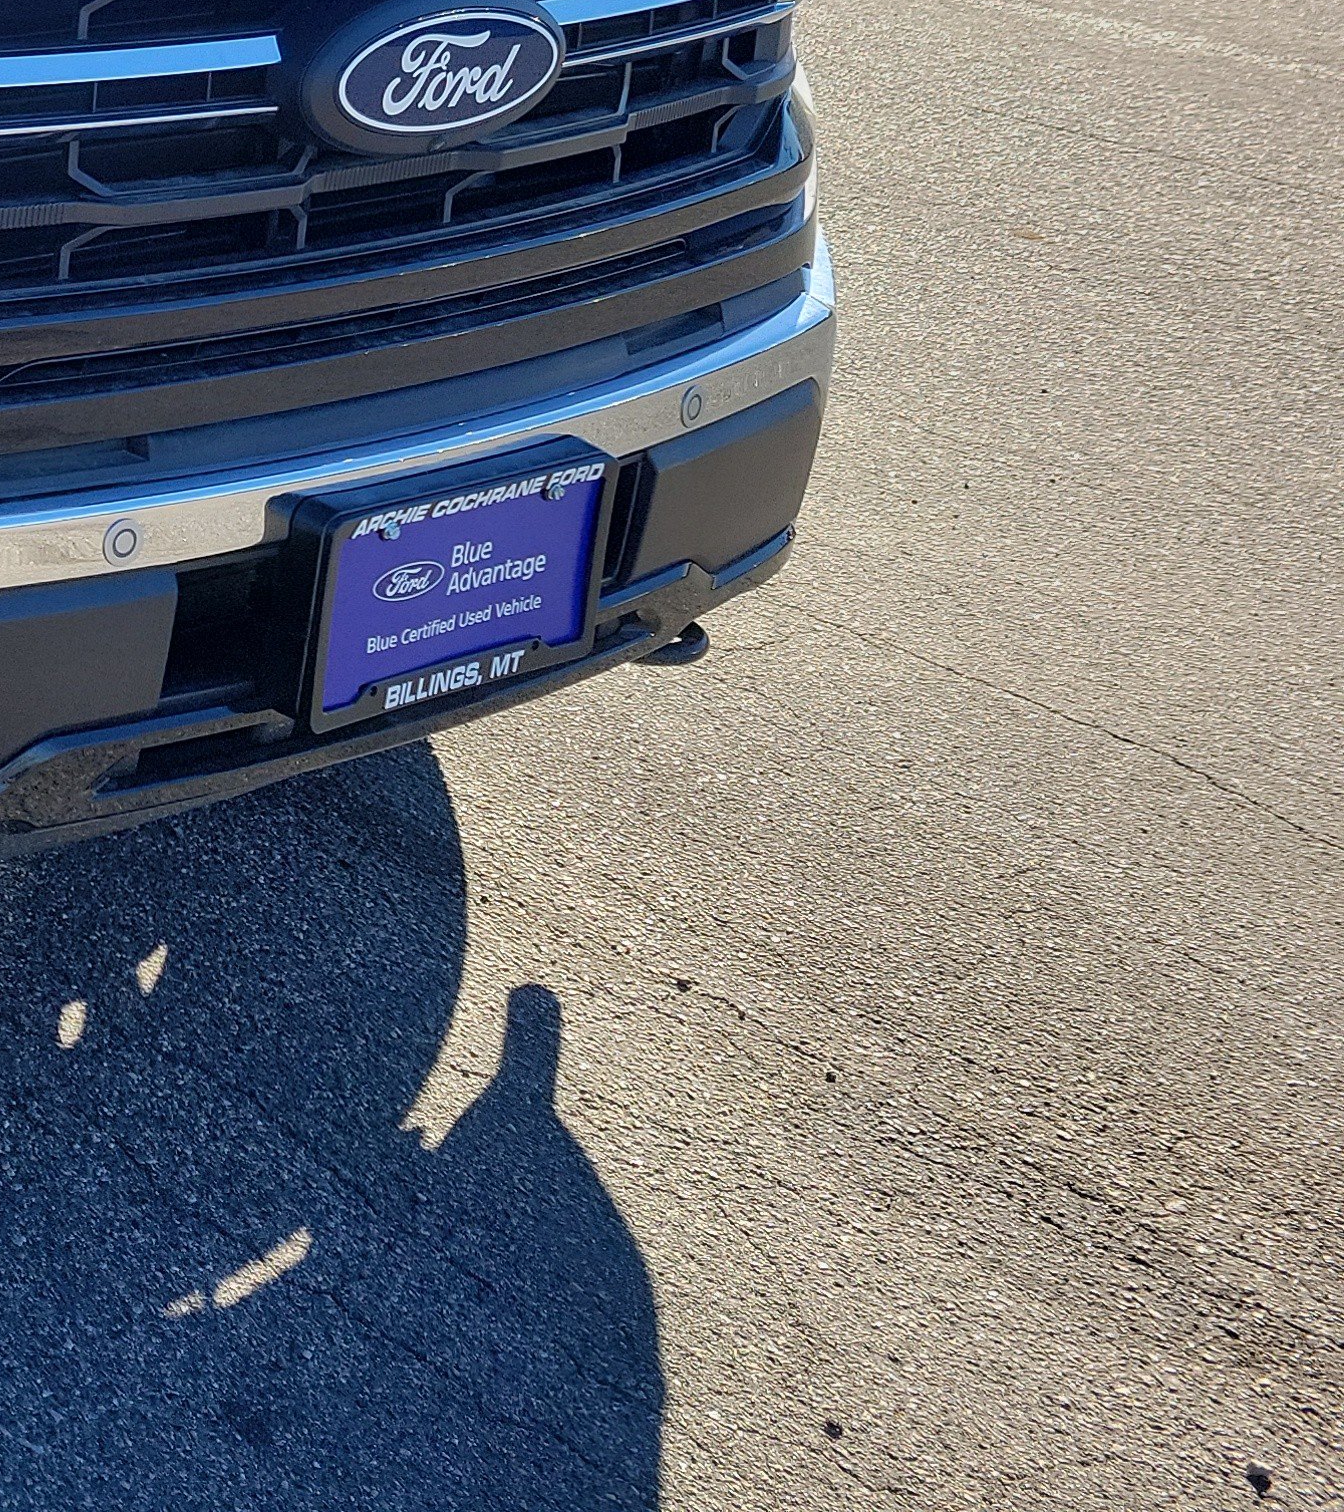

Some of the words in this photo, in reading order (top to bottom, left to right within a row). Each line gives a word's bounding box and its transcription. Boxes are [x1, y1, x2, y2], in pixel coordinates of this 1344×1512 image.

[382, 29, 521, 116] Ford
[351, 504, 431, 540] ARCHIE
[432, 475, 547, 519] COCHRANE
[546, 463, 605, 490] FORD
[386, 567, 433, 597] Ford
[446, 554, 547, 596] Advantage
[451, 541, 493, 568] Blue
[366, 634, 397, 654] Blue
[401, 615, 457, 645] Certified
[459, 605, 492, 628] Used
[495, 595, 542, 618] Vehicle
[384, 661, 483, 710] BILLINGS,
[490, 649, 525, 679] MT
